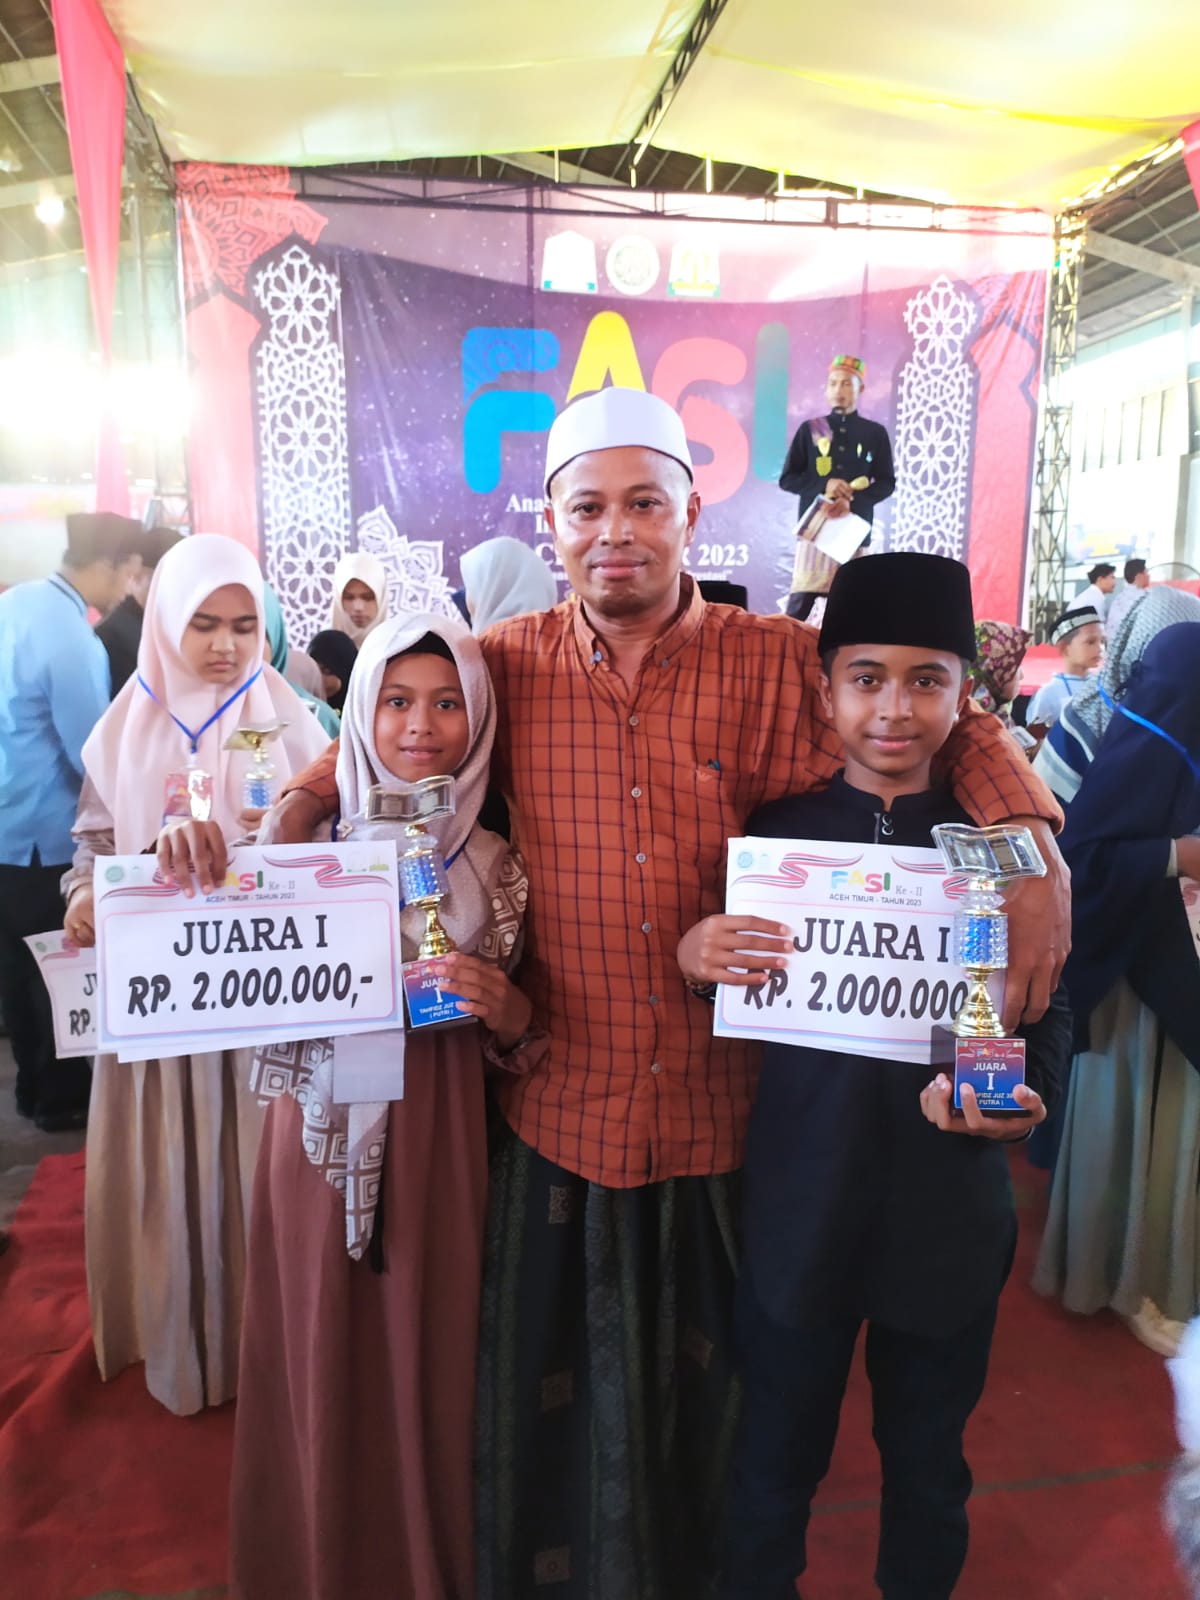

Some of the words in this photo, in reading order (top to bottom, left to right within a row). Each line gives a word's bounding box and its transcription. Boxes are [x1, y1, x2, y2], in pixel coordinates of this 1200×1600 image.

[461, 310, 790, 506] FASI
[697, 543, 749, 566] 2023
[224, 870, 264, 892] ASI
[831, 869, 891, 893] FASI
[895, 885, 907, 895] Ke
[205, 895, 226, 903] ACEH
[829, 893, 850, 901] ACEH
[852, 895, 874, 903] TIMUR
[881, 897, 904, 905] TAHUN
[173, 916, 303, 957] JUARA
[315, 914, 329, 948] I
[793, 917, 925, 962] JUARA
[937, 927, 951, 962] I
[127, 974, 177, 1018] RP.
[191, 962, 373, 1010] 2.000.000,-
[743, 967, 793, 1010] RP.
[69, 1008, 96, 1036] RP.
[973, 1062, 1007, 1071] JUARA
[987, 1072, 995, 1091] I
